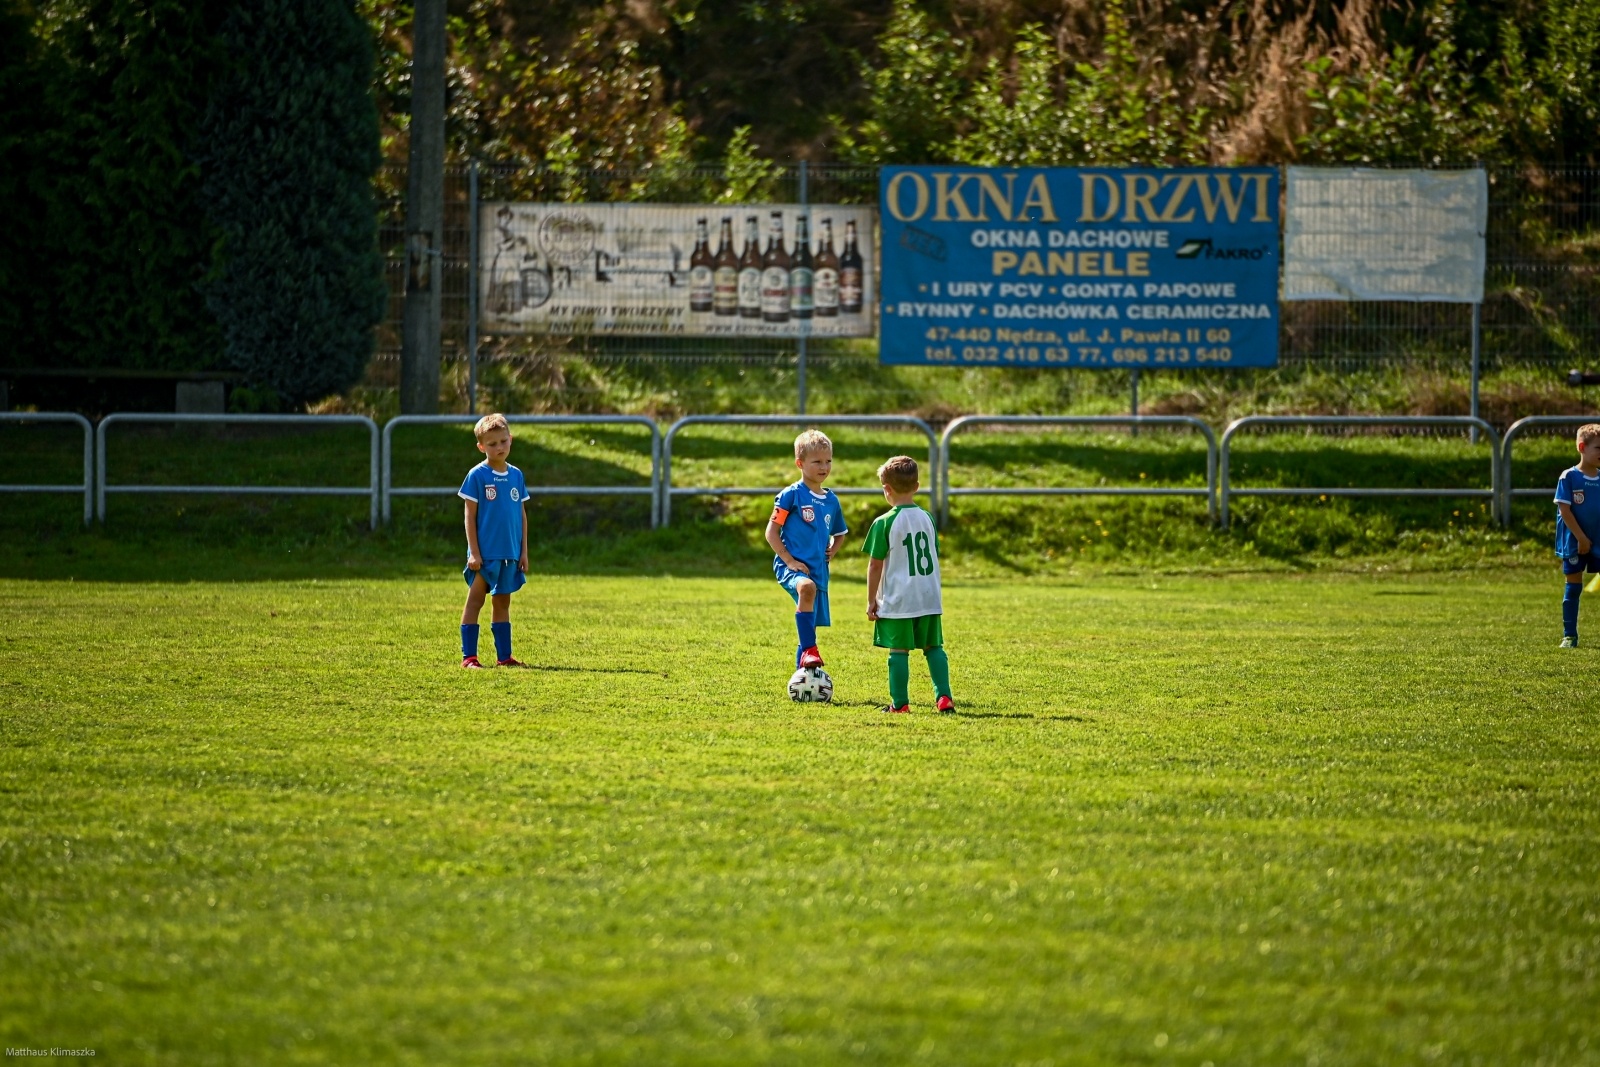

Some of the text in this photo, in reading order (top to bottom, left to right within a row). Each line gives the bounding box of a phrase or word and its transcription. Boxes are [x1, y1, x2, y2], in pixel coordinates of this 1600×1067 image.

[885, 171, 1273, 223] OKNA DRZWI
[970, 229, 1169, 248] OKNA DACHOWE
[992, 251, 1150, 277] PANELE
[999, 282, 1043, 297] PCV
[1061, 283, 1138, 298] GONTA
[1143, 283, 1237, 298] PAPOWE
[898, 301, 1271, 319] RYNNY DACHÓWKA CERAMICZNA
[925, 327, 992, 341] 47-440
[996, 327, 1063, 345] Nędza,
[1068, 327, 1091, 343] ul.
[1097, 328, 1114, 343] J.
[1120, 328, 1181, 343] Pawła
[1206, 328, 1231, 343] 60
[925, 346, 1232, 364] tel. 032 418 63 77, 696 213 540
[902, 531, 934, 576] 18
